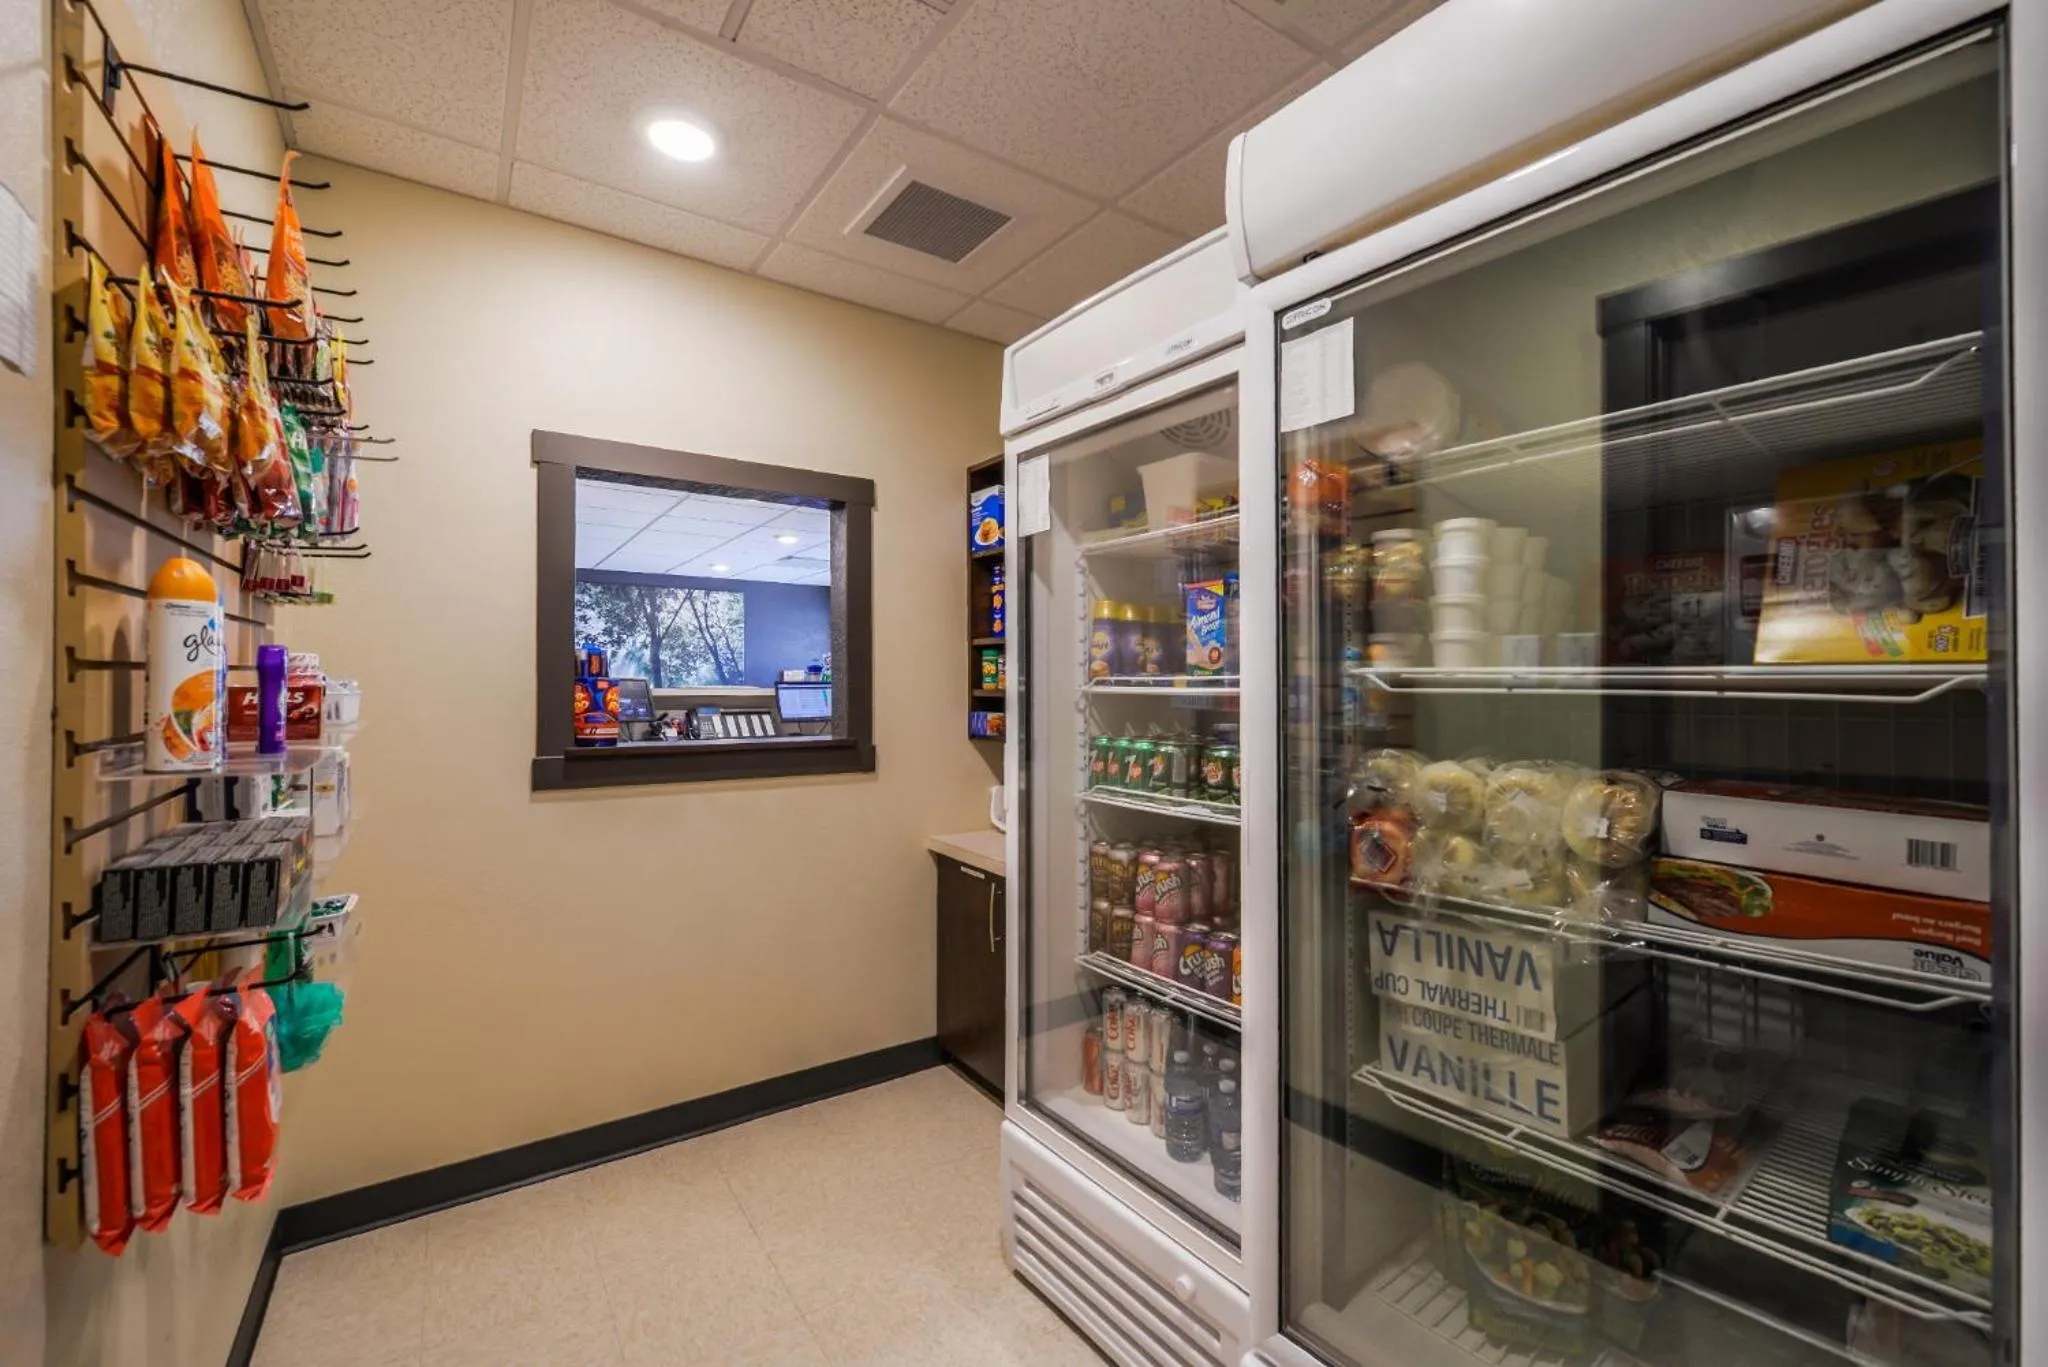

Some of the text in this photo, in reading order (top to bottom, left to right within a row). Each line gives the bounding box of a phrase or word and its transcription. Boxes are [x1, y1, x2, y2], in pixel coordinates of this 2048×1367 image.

[1776, 539, 1797, 584] CHEEMO
[243, 691, 305, 706] HLS
[1376, 920, 1541, 992] VANILLA
[1912, 949, 1965, 968] Value
[1373, 969, 1511, 1024] THERMAL CUP
[1412, 1007, 1561, 1066] COUPE THERMALE
[1386, 1033, 1561, 1125] VANILLE
